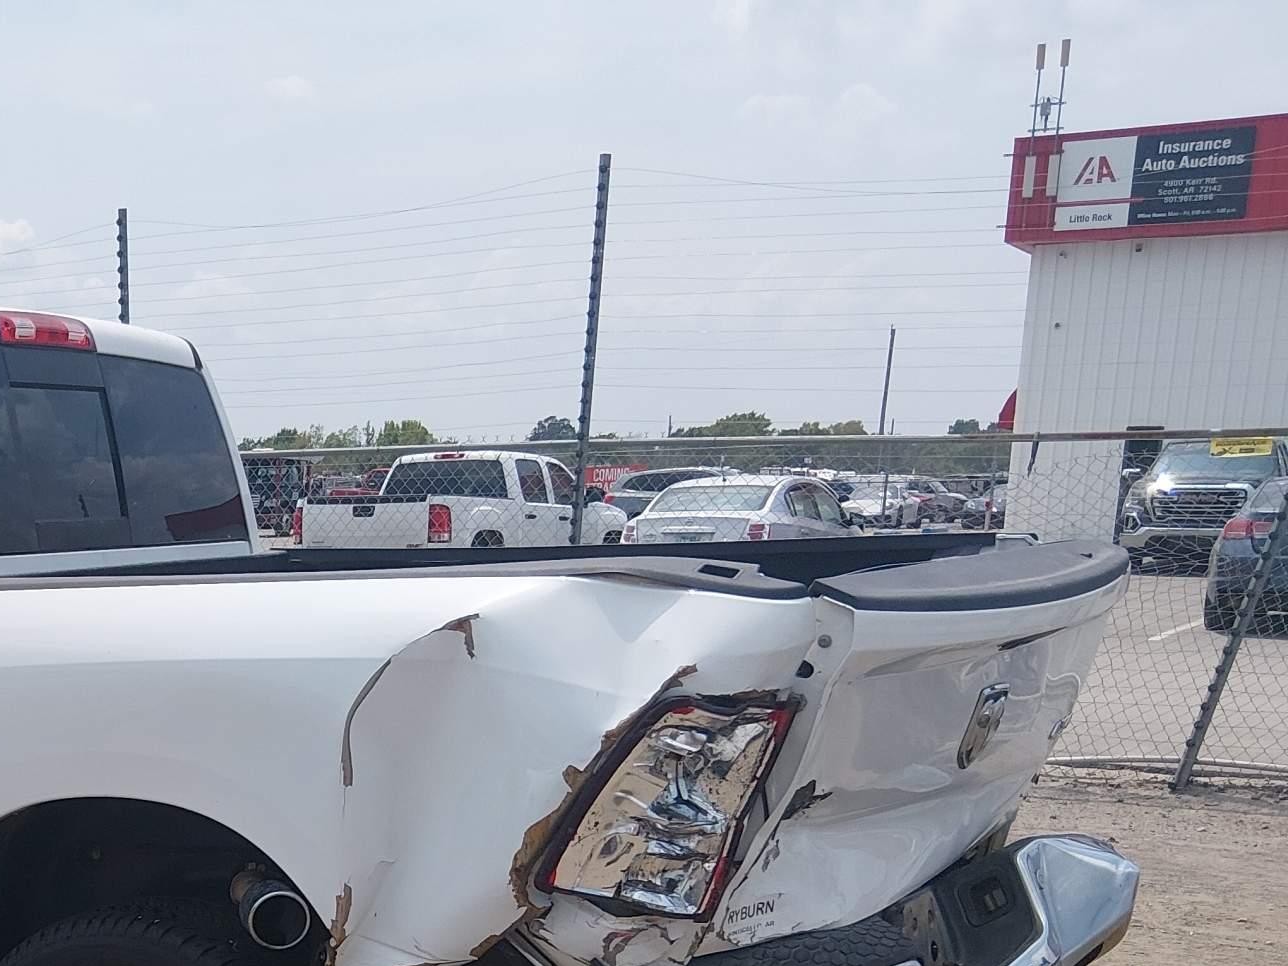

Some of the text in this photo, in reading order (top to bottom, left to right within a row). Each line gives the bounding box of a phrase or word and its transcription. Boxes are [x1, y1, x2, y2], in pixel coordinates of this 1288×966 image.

[1158, 138, 1232, 154] Insurance
[1142, 153, 1245, 172] Auto Auctions
[1069, 212, 1113, 224] Little Rock
[727, 899, 775, 925] RYBURN
